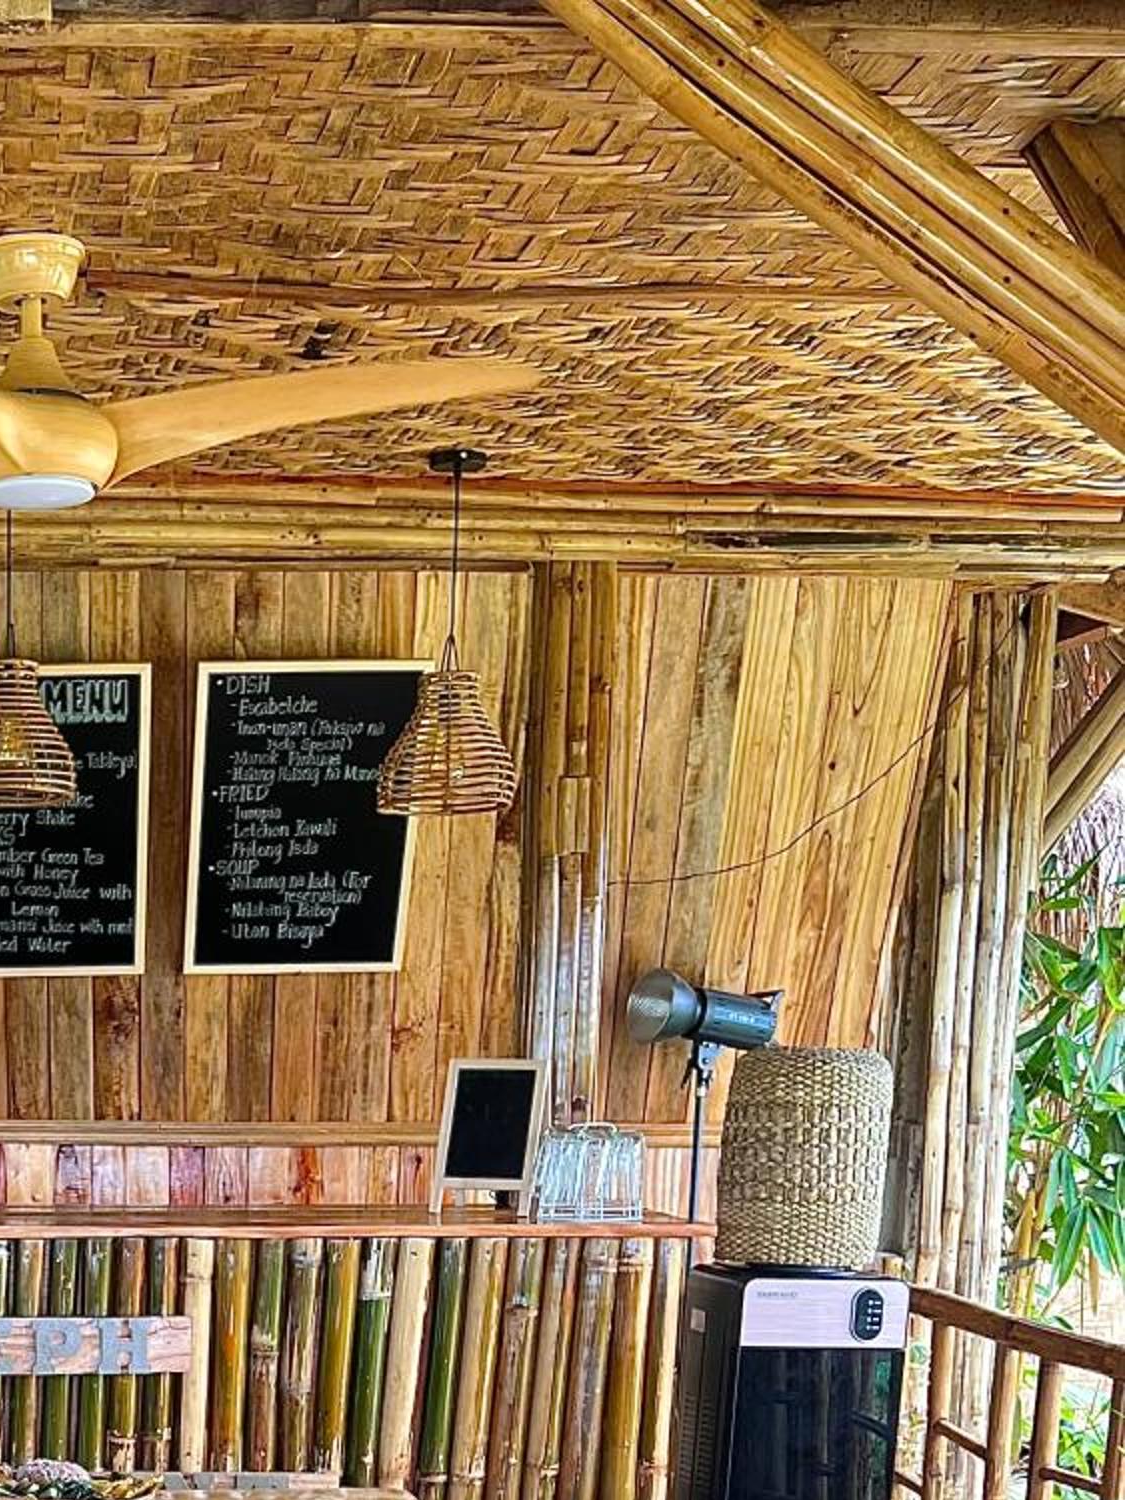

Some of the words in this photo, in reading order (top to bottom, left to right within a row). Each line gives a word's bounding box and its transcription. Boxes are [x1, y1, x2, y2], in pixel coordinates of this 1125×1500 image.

[226, 675, 270, 694] DISH
[41, 679, 129, 723] MENU
[366, 721, 386, 736] na
[233, 751, 279, 766] Manok
[219, 785, 269, 802] FRIED
[35, 809, 76, 826] Shake
[294, 818, 338, 837] Kawali
[41, 849, 79, 865] Green
[82, 848, 105, 866] Tea
[33, 864, 79, 886] Honey
[215, 860, 260, 876] SOUP
[53, 882, 92, 900] Juice
[99, 883, 132, 901] with
[11, 901, 60, 918] Lemon
[41, 917, 75, 934] Juice
[79, 917, 104, 934] with
[27, 936, 72, 954] Water
